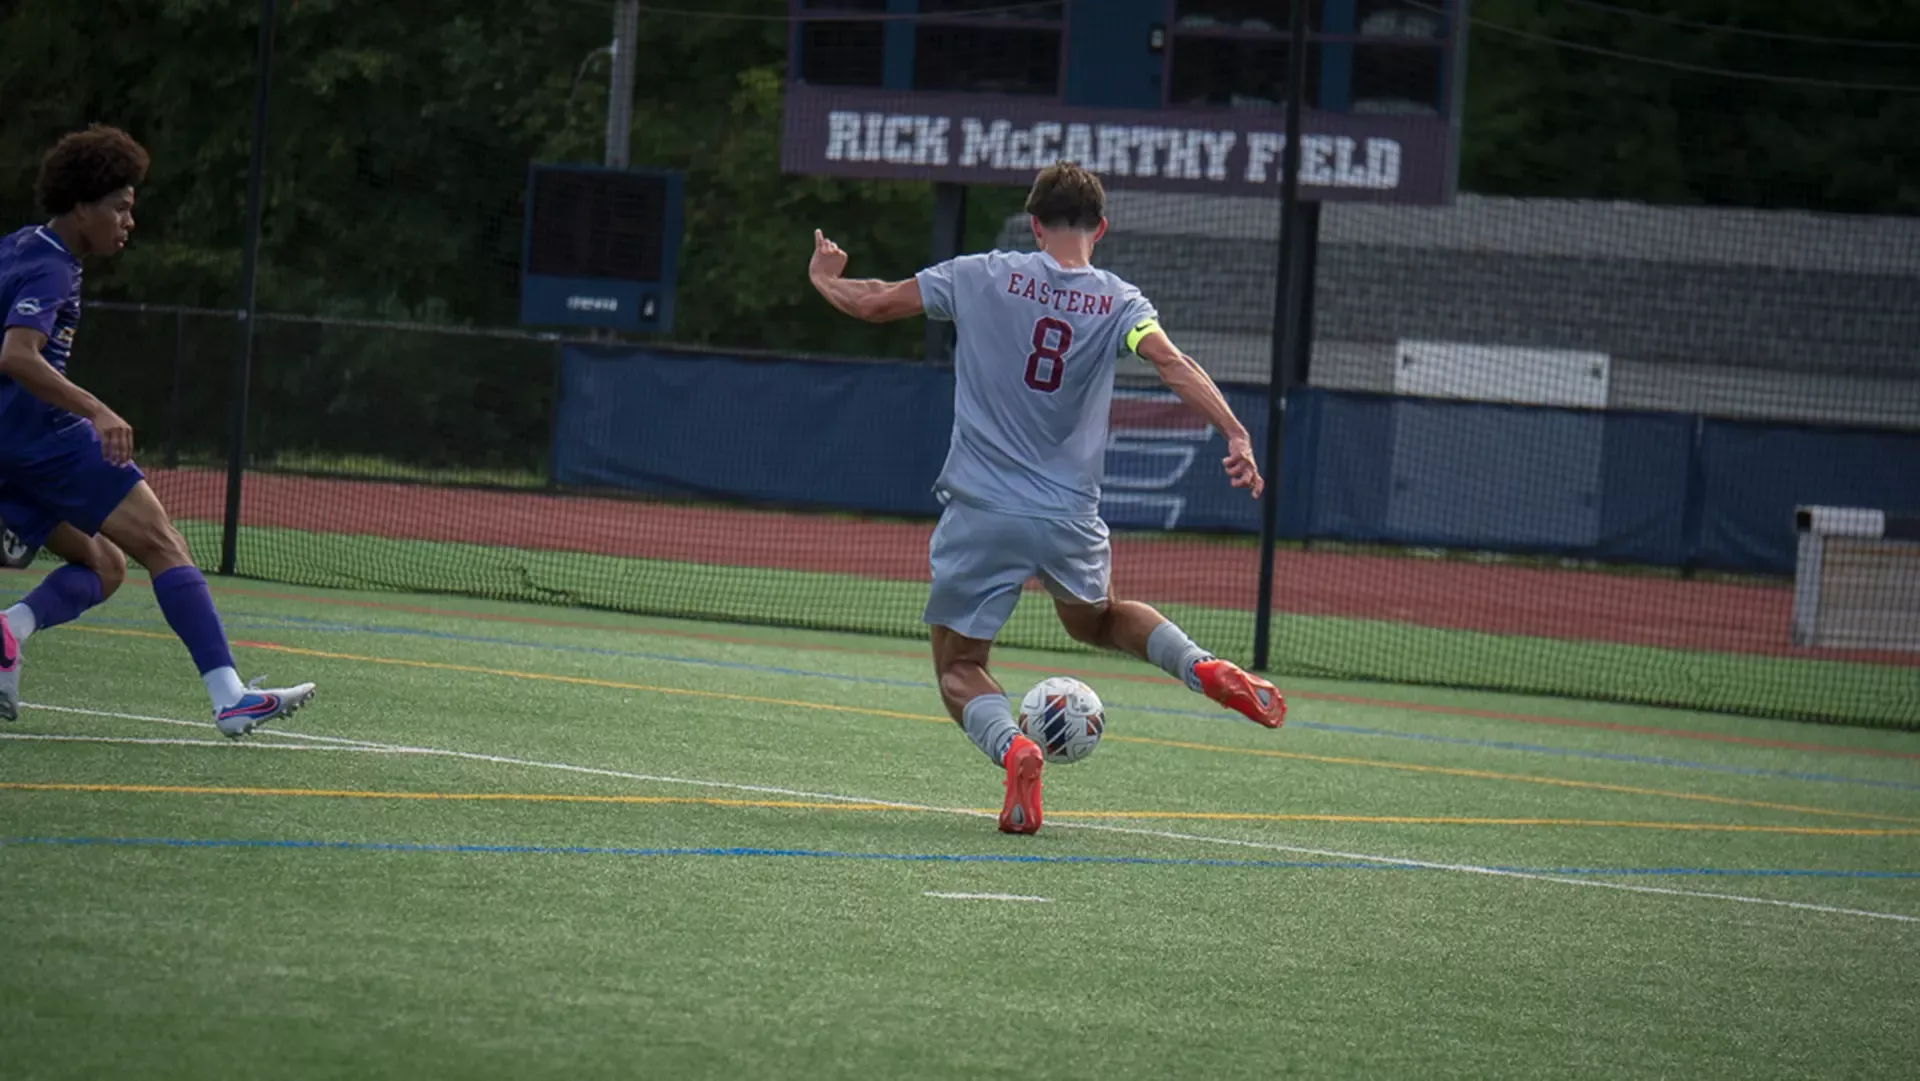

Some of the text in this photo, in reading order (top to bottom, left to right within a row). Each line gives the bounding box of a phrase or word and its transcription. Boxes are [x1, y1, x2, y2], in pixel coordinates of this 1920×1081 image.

[825, 111, 1402, 189] RICK McCARTHY FELD
[1007, 272, 1114, 316] EASTERN
[1022, 315, 1074, 395] 8
